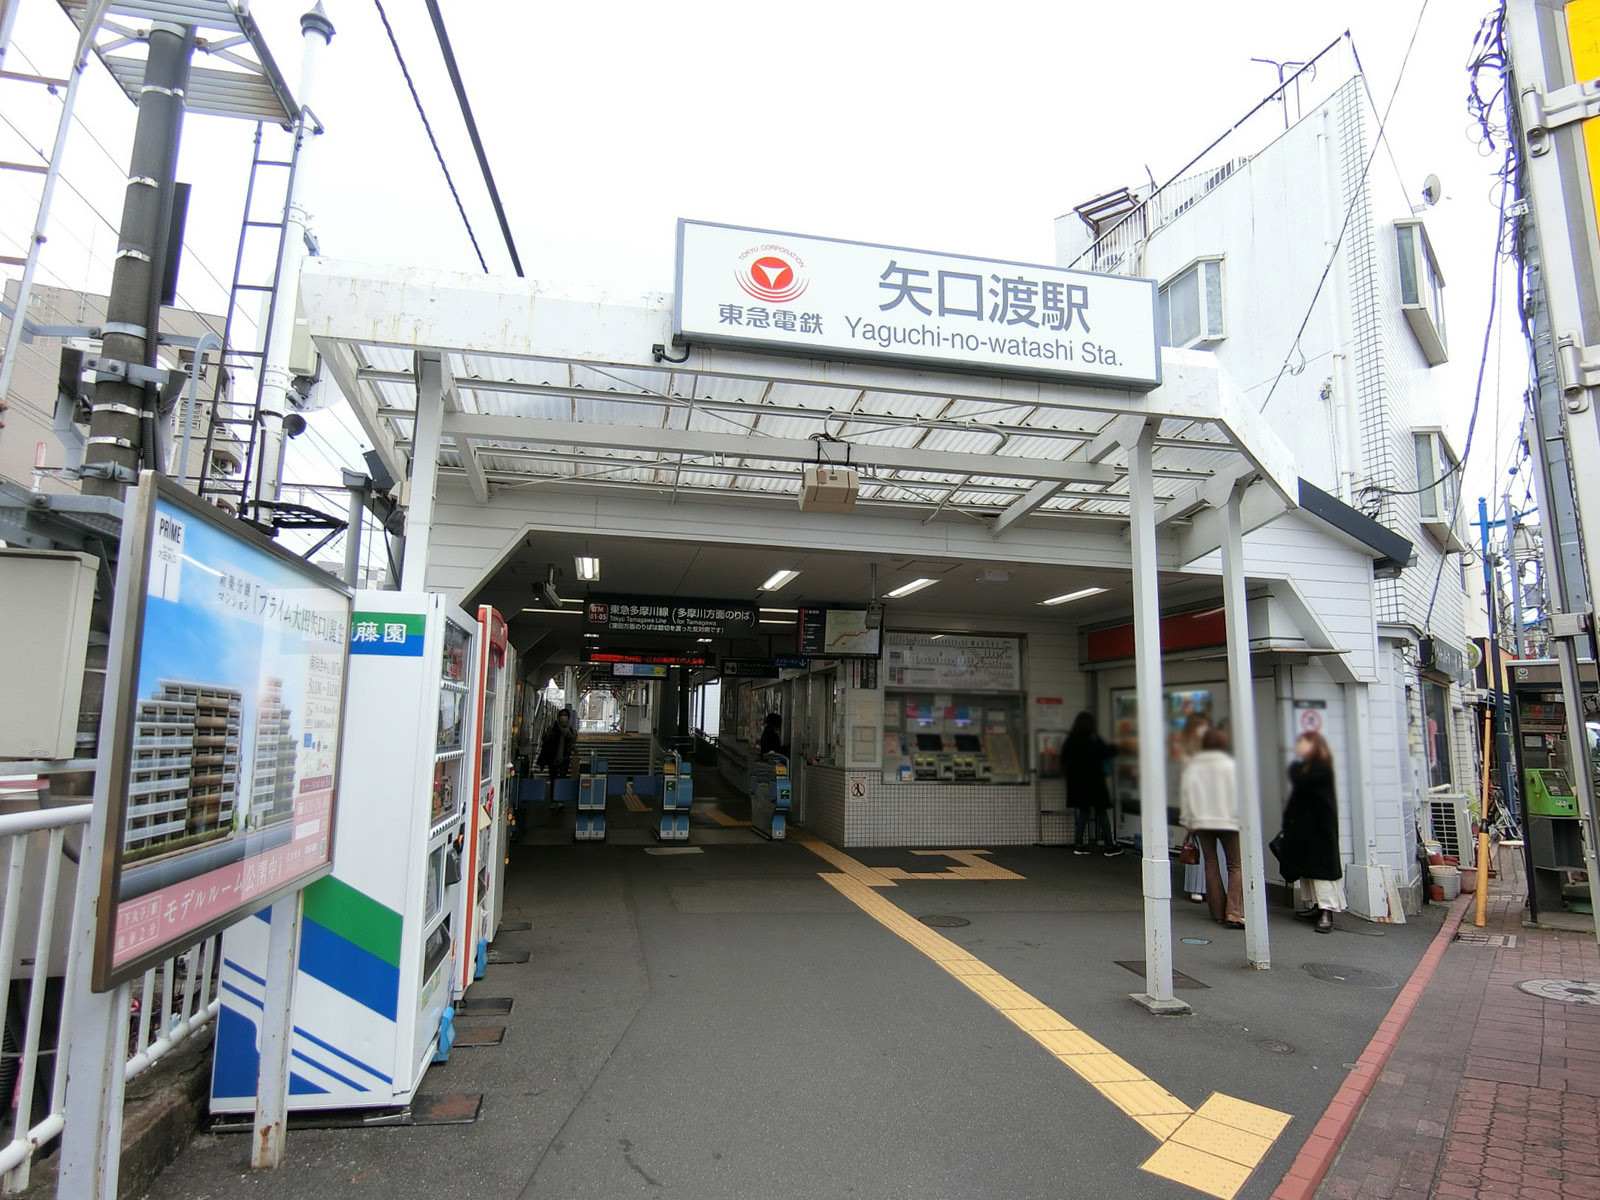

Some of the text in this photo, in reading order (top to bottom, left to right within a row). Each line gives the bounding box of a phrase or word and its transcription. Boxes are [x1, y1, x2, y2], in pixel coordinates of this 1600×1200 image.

[739, 244, 805, 268] TOKYU CORPORATION
[879, 260, 1091, 334] 矢口渡駅
[718, 304, 824, 334] 東急電鉄
[845, 316, 1123, 367] Yaguchi-no-watashi Sta.
[159, 517, 182, 544] PRIME
[610, 604, 669, 617] 東急多摩川線
[352, 621, 407, 644] 藤園
